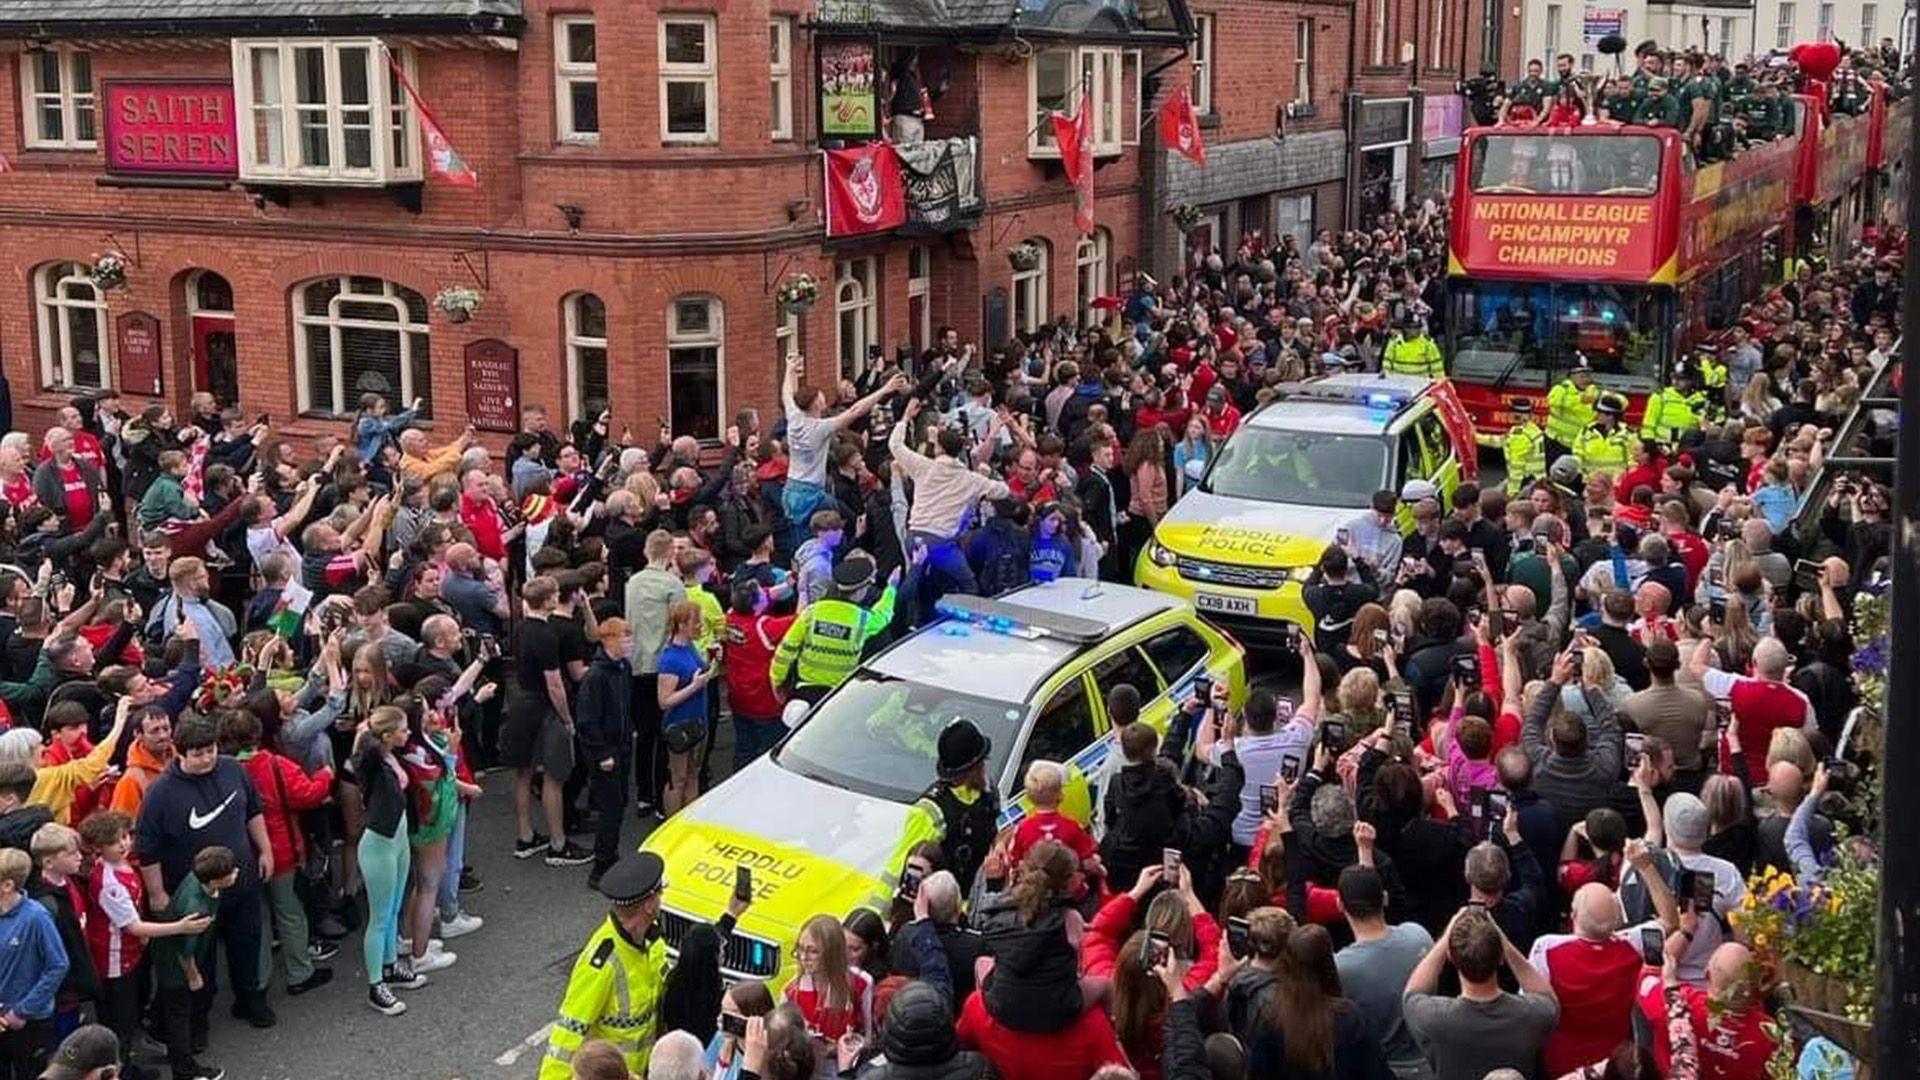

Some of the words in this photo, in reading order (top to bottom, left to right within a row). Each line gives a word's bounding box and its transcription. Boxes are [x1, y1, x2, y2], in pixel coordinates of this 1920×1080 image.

[122, 96, 224, 125] SAITH
[119, 134, 230, 164] SEREN
[1475, 203, 1568, 221] NATIONAL
[1572, 204, 1650, 223] LEAGUE
[1488, 224, 1630, 244] PENCAMPWYR
[1498, 245, 1618, 267] CHAMPIONS
[1202, 526, 1290, 544] HEDDLU
[1198, 538, 1277, 557] POLICE
[1226, 598, 1251, 612] AXH
[705, 841, 807, 880] HEDDLU
[687, 862, 780, 900] POLCE
